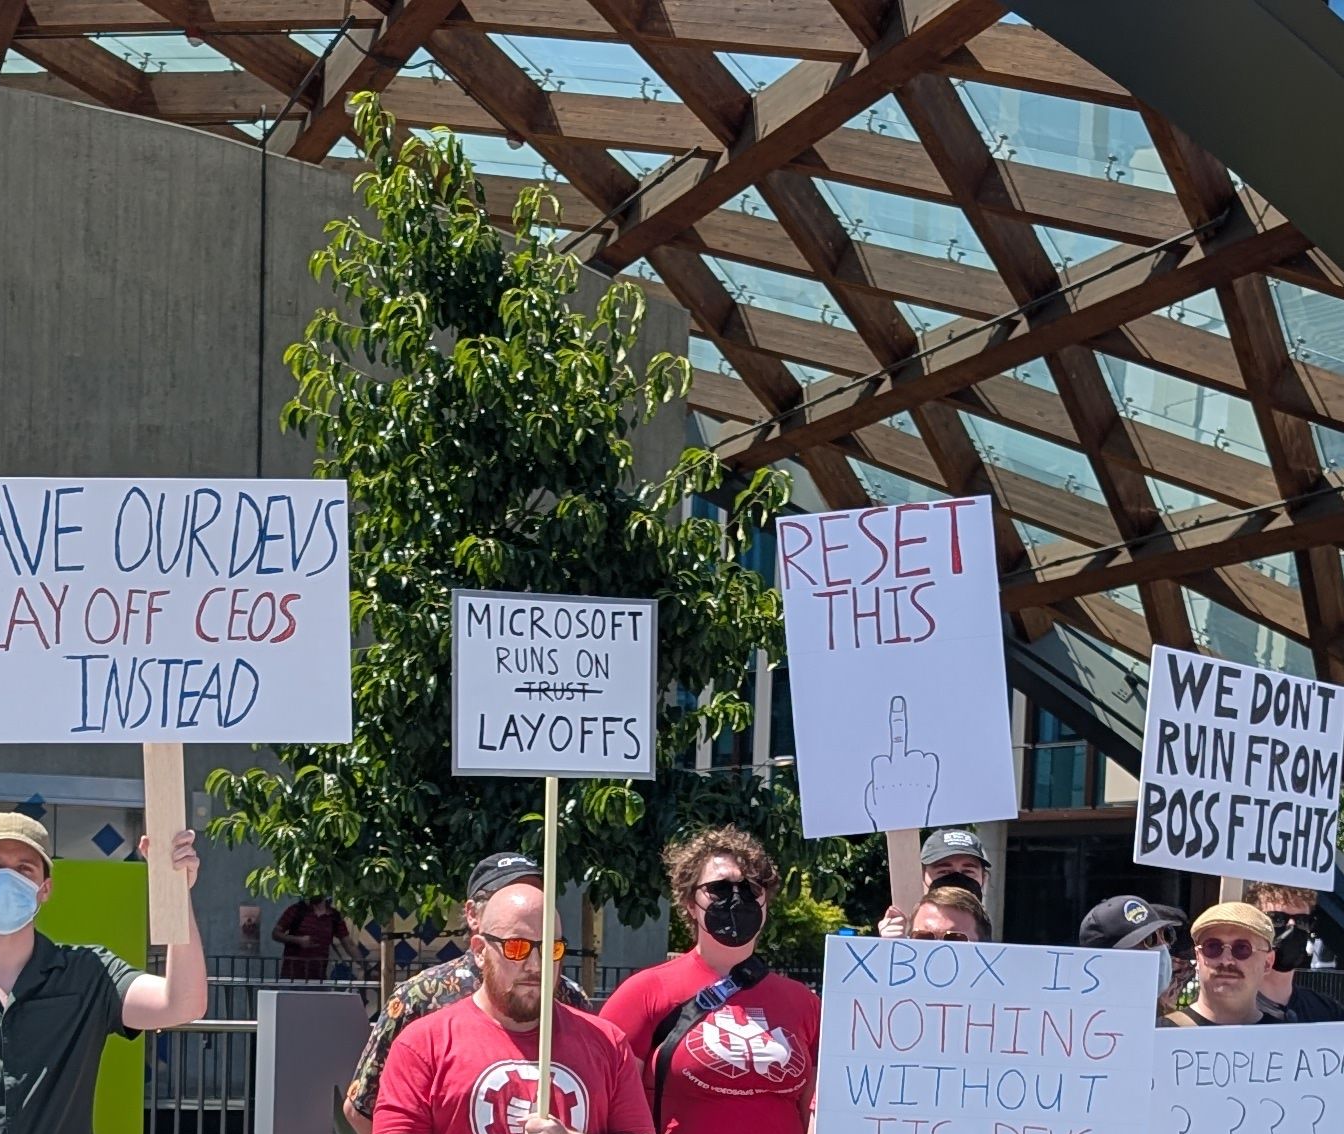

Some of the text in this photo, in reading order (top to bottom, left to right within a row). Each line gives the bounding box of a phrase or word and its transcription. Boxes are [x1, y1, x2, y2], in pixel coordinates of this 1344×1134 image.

[115, 486, 222, 579] OUR
[228, 489, 344, 577] DEVS
[778, 500, 975, 590] RESET
[84, 588, 171, 644] OFF
[196, 586, 302, 643] CEOS
[467, 602, 642, 641] MICROSOFT
[813, 581, 935, 650] THIS
[496, 646, 608, 679] RUNS ON
[523, 681, 589, 702] TRUST
[63, 654, 258, 733] INSTEAD
[1167, 653, 1337, 735] WE DON'T
[478, 713, 641, 760] LAYOFFS
[1155, 718, 1339, 800] RUN FROM
[1140, 782, 1338, 875] BOSS FIGHTS
[841, 941, 1102, 994] XBOX IS
[850, 997, 1124, 1060] NOTHING
[845, 1064, 1108, 1114] WITHOUT
[1172, 1048, 1284, 1088] PEOPLE
[1294, 1048, 1318, 1081] A
